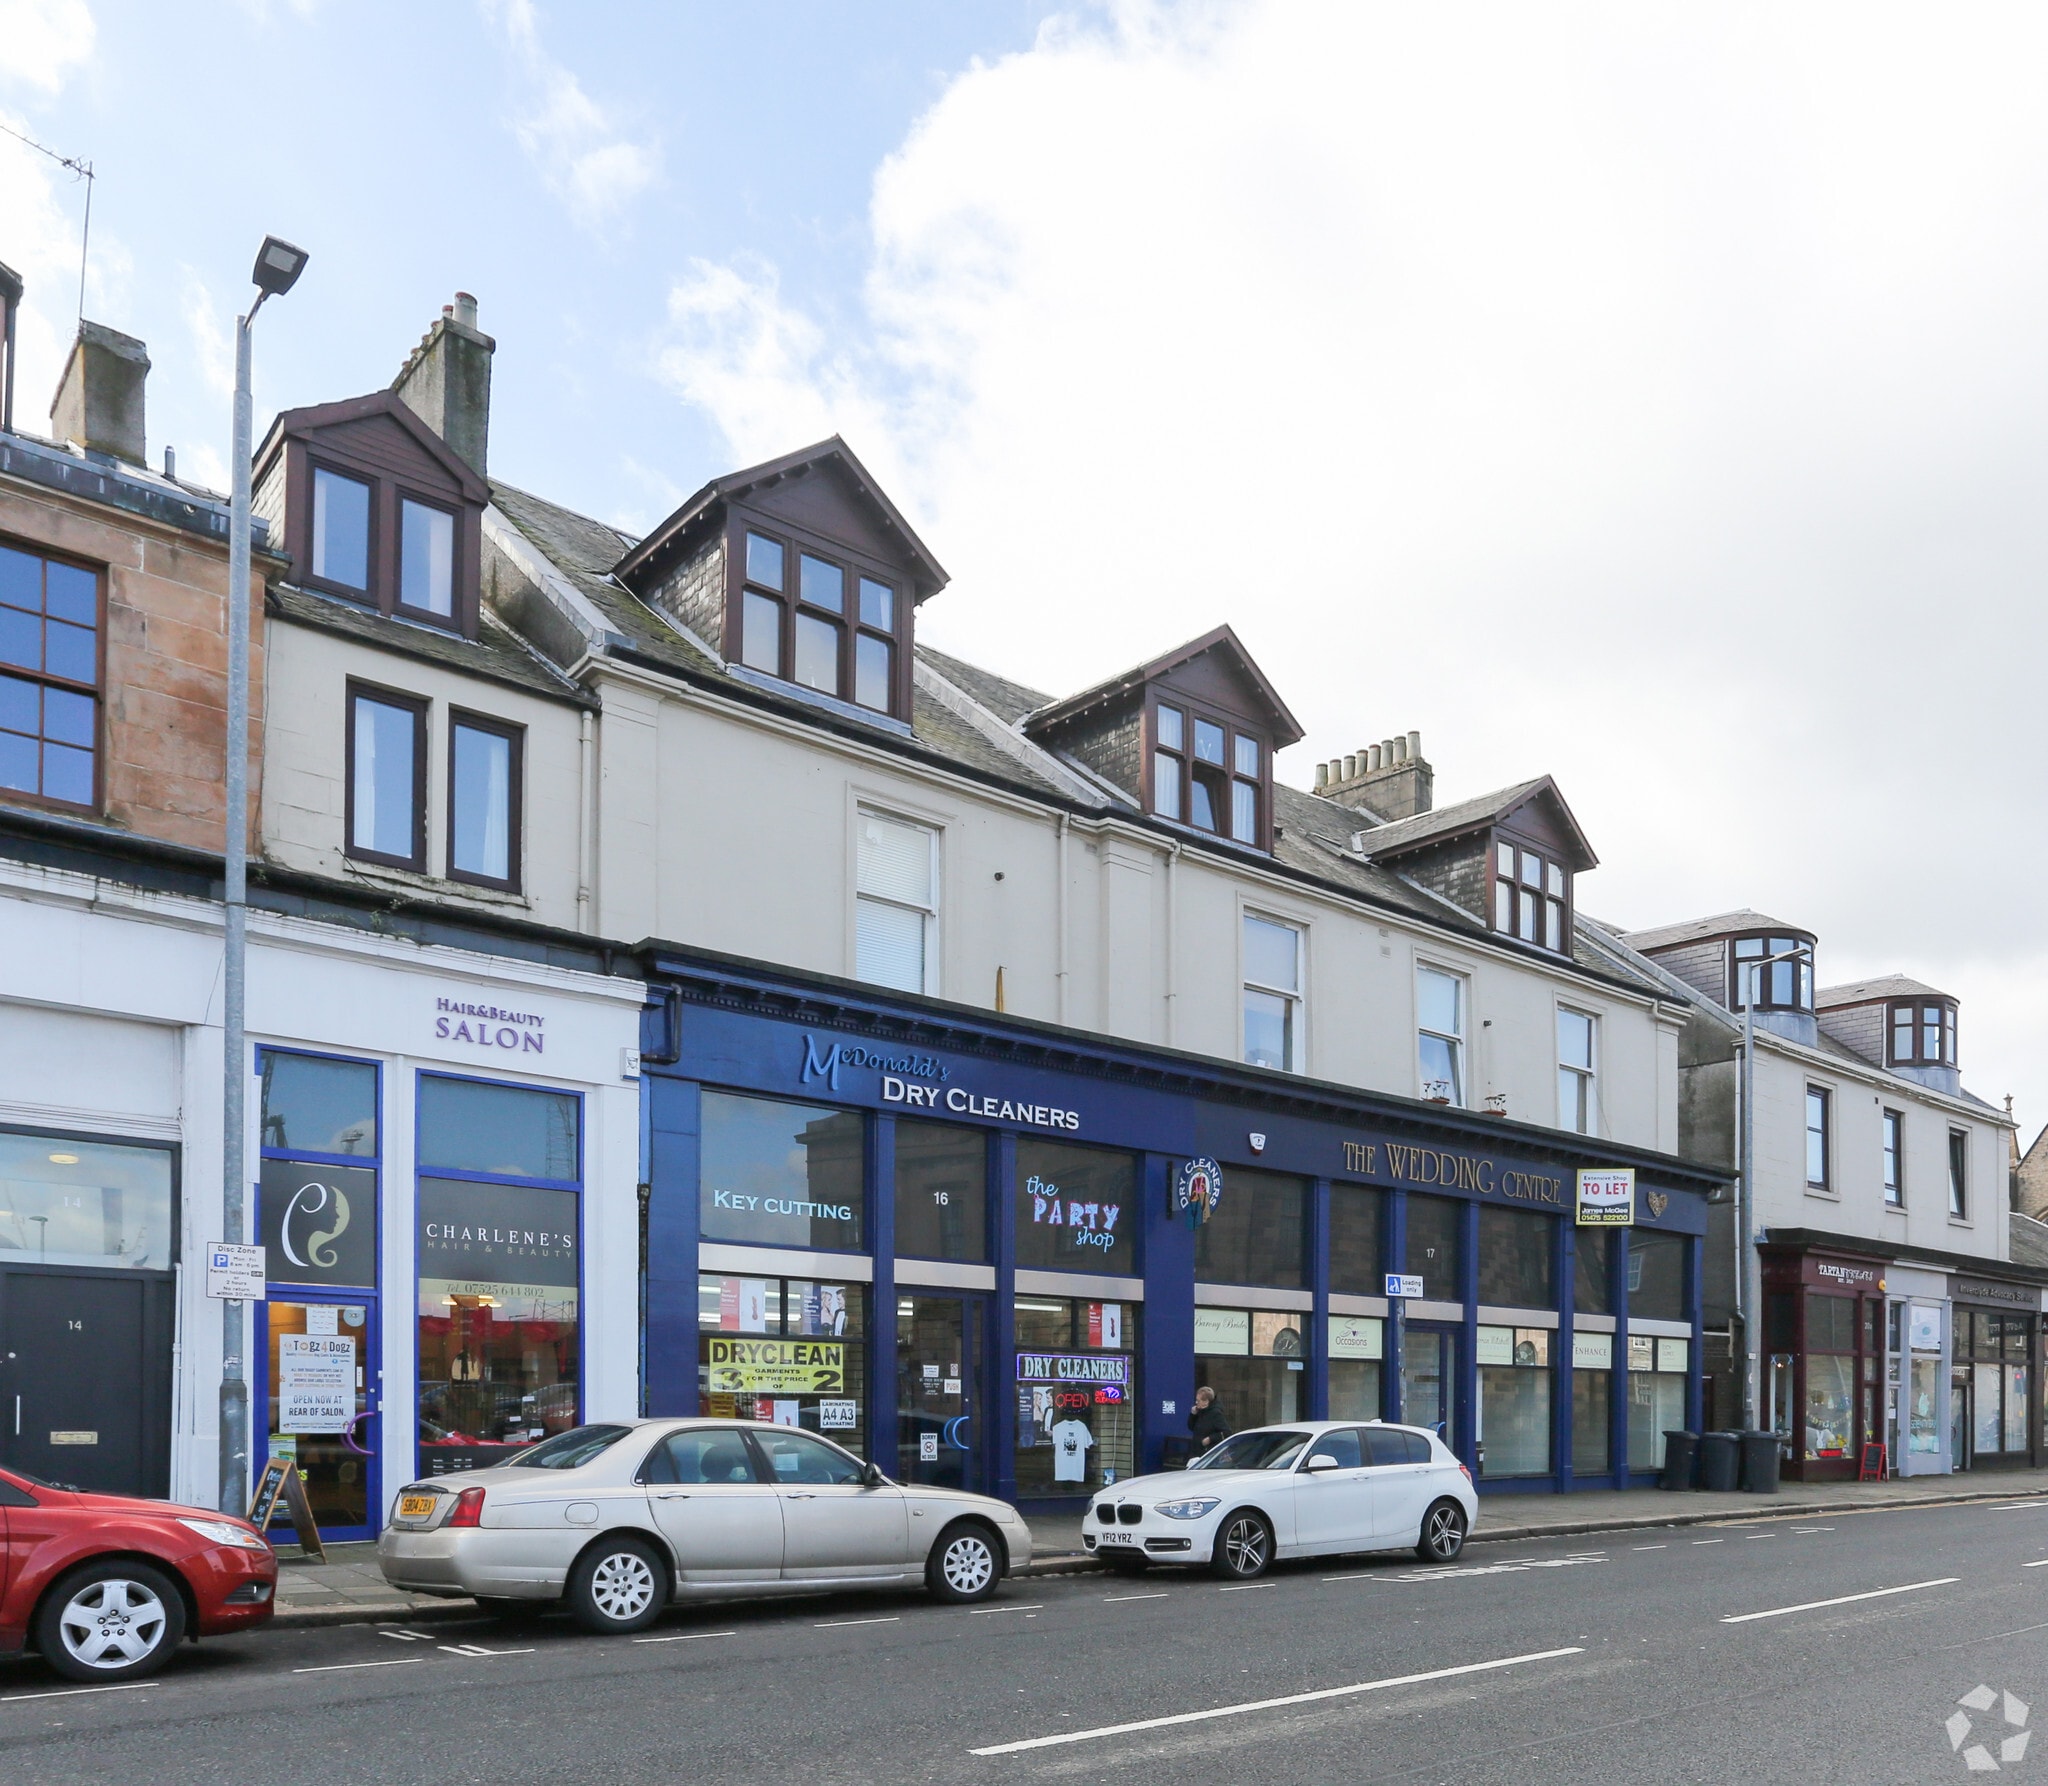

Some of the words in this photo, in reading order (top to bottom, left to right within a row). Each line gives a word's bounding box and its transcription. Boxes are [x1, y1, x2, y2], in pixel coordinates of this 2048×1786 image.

[436, 1016, 545, 1053] SALON
[801, 1033, 951, 1091] McDonald's
[883, 1075, 940, 1107] DRY
[946, 1087, 1080, 1130] CLEANERS
[1342, 1141, 1376, 1176] THE
[1384, 1142, 1496, 1194] WEDDING
[1502, 1170, 1561, 1204] CENTRE
[1025, 1175, 1059, 1197] the
[1179, 1176, 1189, 1209] DRY
[1184, 1158, 1221, 1207] CLEANERS
[1583, 1183, 1600, 1195] TO
[1605, 1183, 1628, 1195] LET
[63, 1196, 81, 1208] 14
[713, 1189, 758, 1211] KEY
[763, 1198, 852, 1221] CUTTING
[934, 1191, 949, 1206] 16
[1033, 1194, 1120, 1231] PARTY
[426, 1223, 572, 1248] CHARLENE'S
[1075, 1226, 1115, 1253] shop
[237, 1246, 257, 1254] Zone
[427, 1240, 470, 1251] HAIR
[485, 1245, 492, 1253] &
[507, 1246, 572, 1259] BEAUTY
[1426, 1248, 1435, 1258] 17
[464, 1284, 499, 1295] 07525
[524, 1287, 545, 1298] 802
[1401, 1279, 1421, 1287] Loading
[68, 1320, 82, 1331] 14
[293, 1340, 321, 1353] Togz
[321, 1341, 328, 1353] 4
[329, 1341, 351, 1353] Dogz
[712, 1342, 841, 1366] DRYCLEAN
[1575, 1346, 1607, 1357] ENHANCE
[1023, 1356, 1053, 1379] DRY
[1057, 1358, 1124, 1381] CLEANERS
[713, 1367, 744, 1391] 3
[812, 1369, 842, 1392] 2
[293, 1395, 313, 1404] OPEN
[315, 1395, 332, 1405] NOW
[334, 1395, 343, 1405] AT
[1055, 1393, 1090, 1409] OPEN
[289, 1407, 308, 1416] REAR
[310, 1407, 320, 1416] OF
[321, 1407, 347, 1417] SALON.
[823, 1408, 837, 1420] A4
[840, 1408, 854, 1421] A3
[1102, 1532, 1116, 1543] YF12
[1117, 1532, 1132, 1543] YRZ
